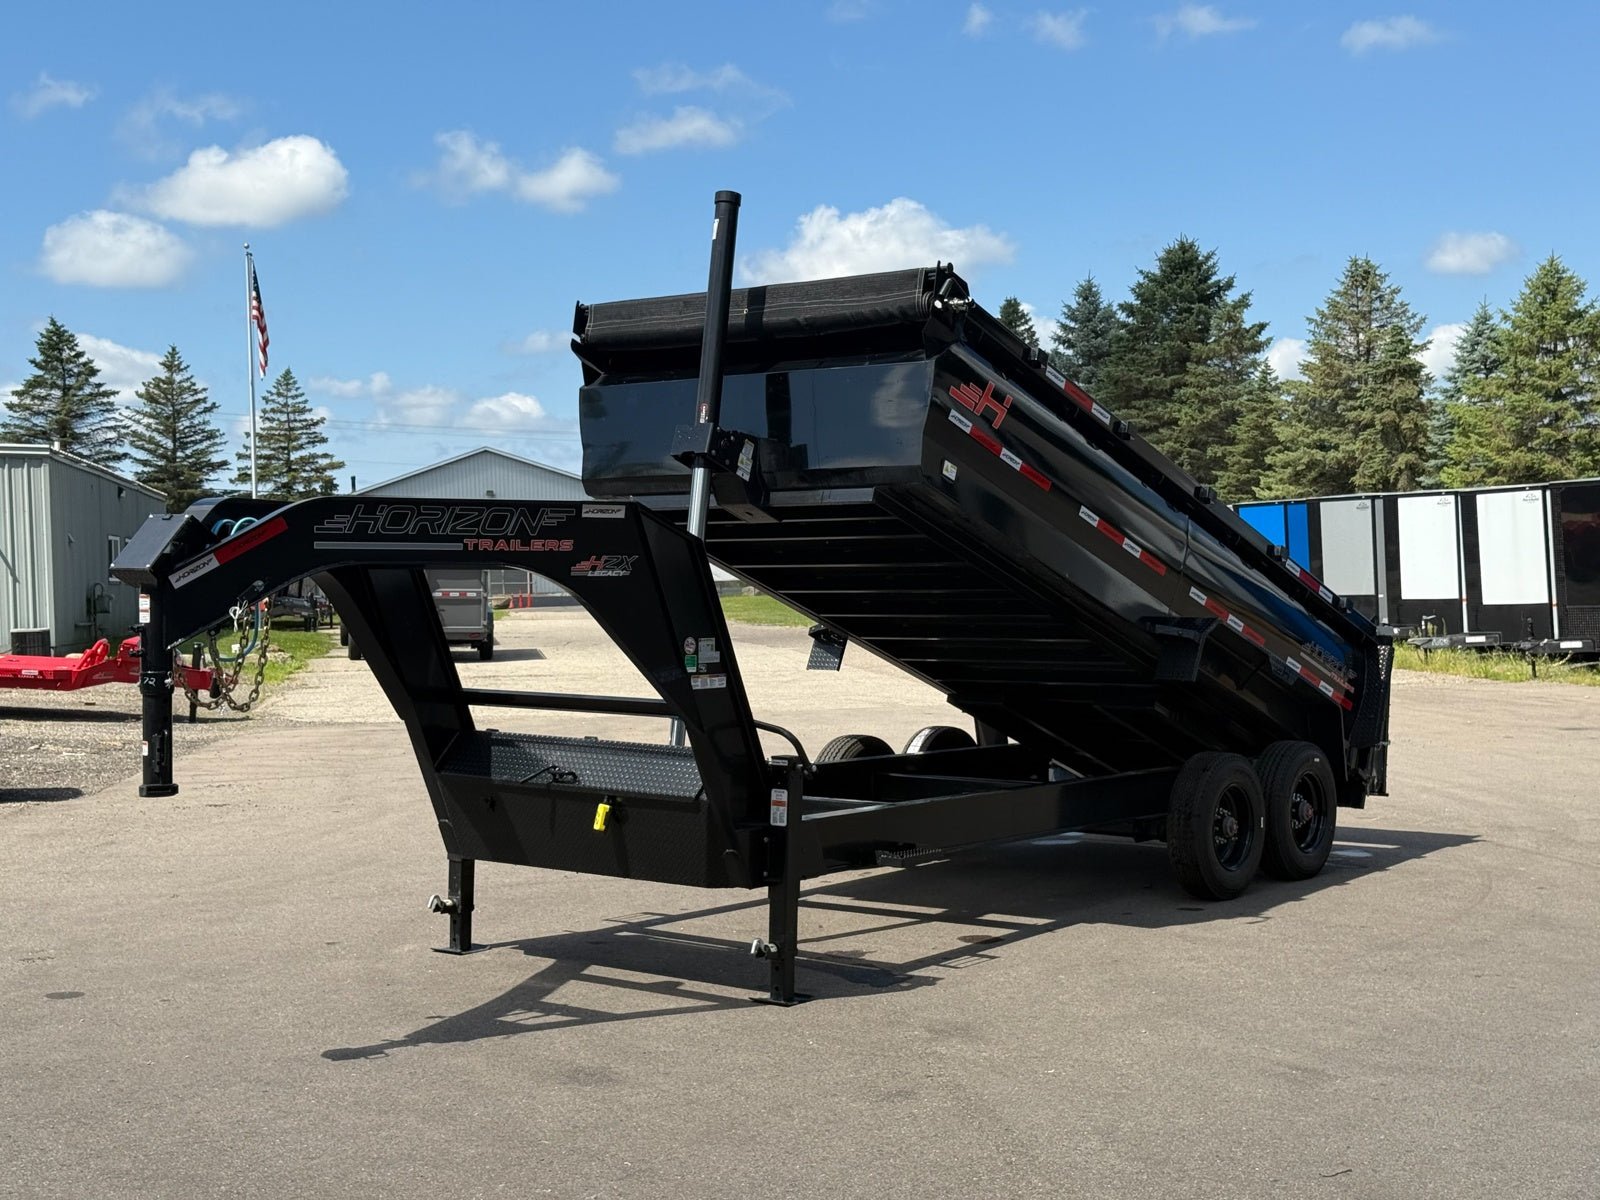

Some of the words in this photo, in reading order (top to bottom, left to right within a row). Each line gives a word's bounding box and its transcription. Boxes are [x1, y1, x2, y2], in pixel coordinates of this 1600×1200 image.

[344, 504, 548, 536] HORIZON
[463, 538, 574, 551] TRAILERS
[176, 557, 212, 583] HORIZON
